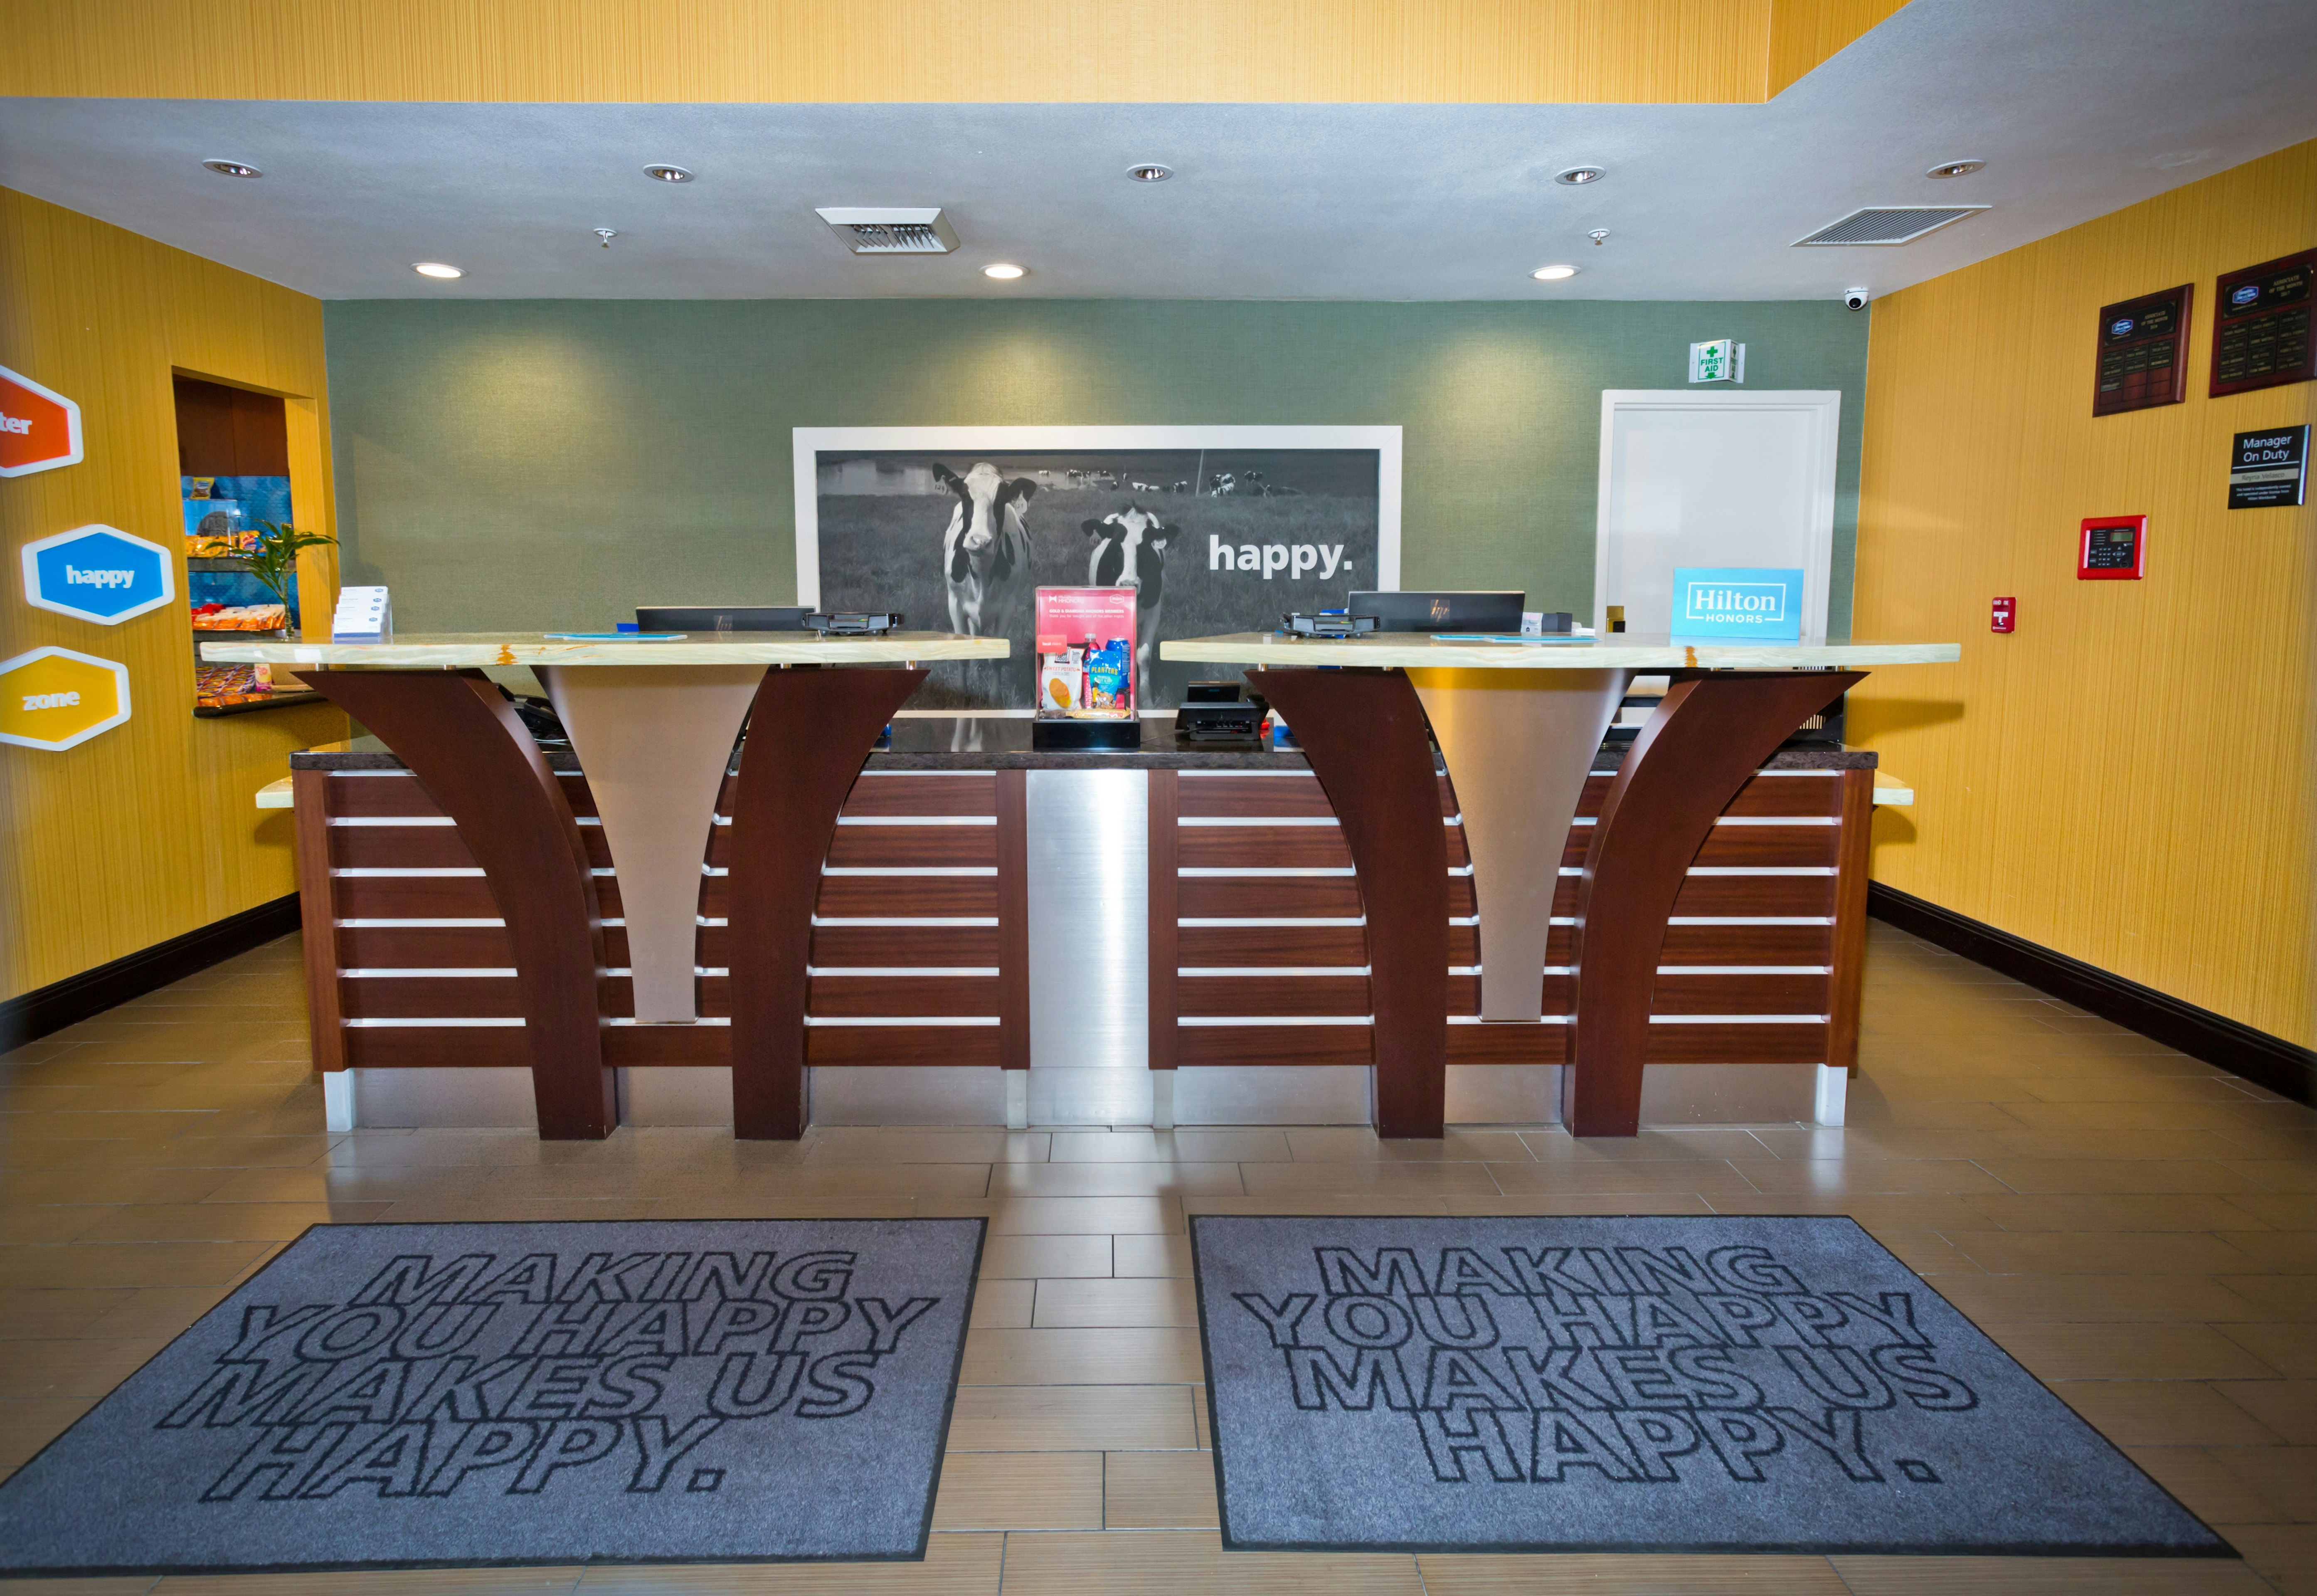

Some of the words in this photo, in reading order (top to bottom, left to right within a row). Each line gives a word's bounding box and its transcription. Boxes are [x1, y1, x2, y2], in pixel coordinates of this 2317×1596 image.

[2243, 436, 2292, 448] Manager
[2243, 453, 2259, 462] On
[2263, 450, 2289, 460] Duty
[66, 565, 135, 589] happy
[1210, 534, 1352, 580] happy.
[1695, 590, 1776, 611] Hilton
[1706, 613, 1763, 623] HONORS
[1091, 667, 1118, 675] PLANTERS
[22, 691, 80, 711] zone
[352, 1252, 856, 1304] MAKING
[1315, 1247, 1813, 1296] MAKING
[217, 1303, 498, 1361] YOU
[513, 1298, 938, 1354] HAPPY
[1233, 1292, 1501, 1350] YOU
[1527, 1292, 1938, 1350] HAPPY
[158, 1354, 674, 1427] MAKES
[708, 1351, 880, 1419] US
[1282, 1345, 1765, 1411] MAKES
[1772, 1345, 1980, 1411] US
[200, 1419, 725, 1502] HAPPY.
[1415, 1406, 1942, 1484] HAPPY.
